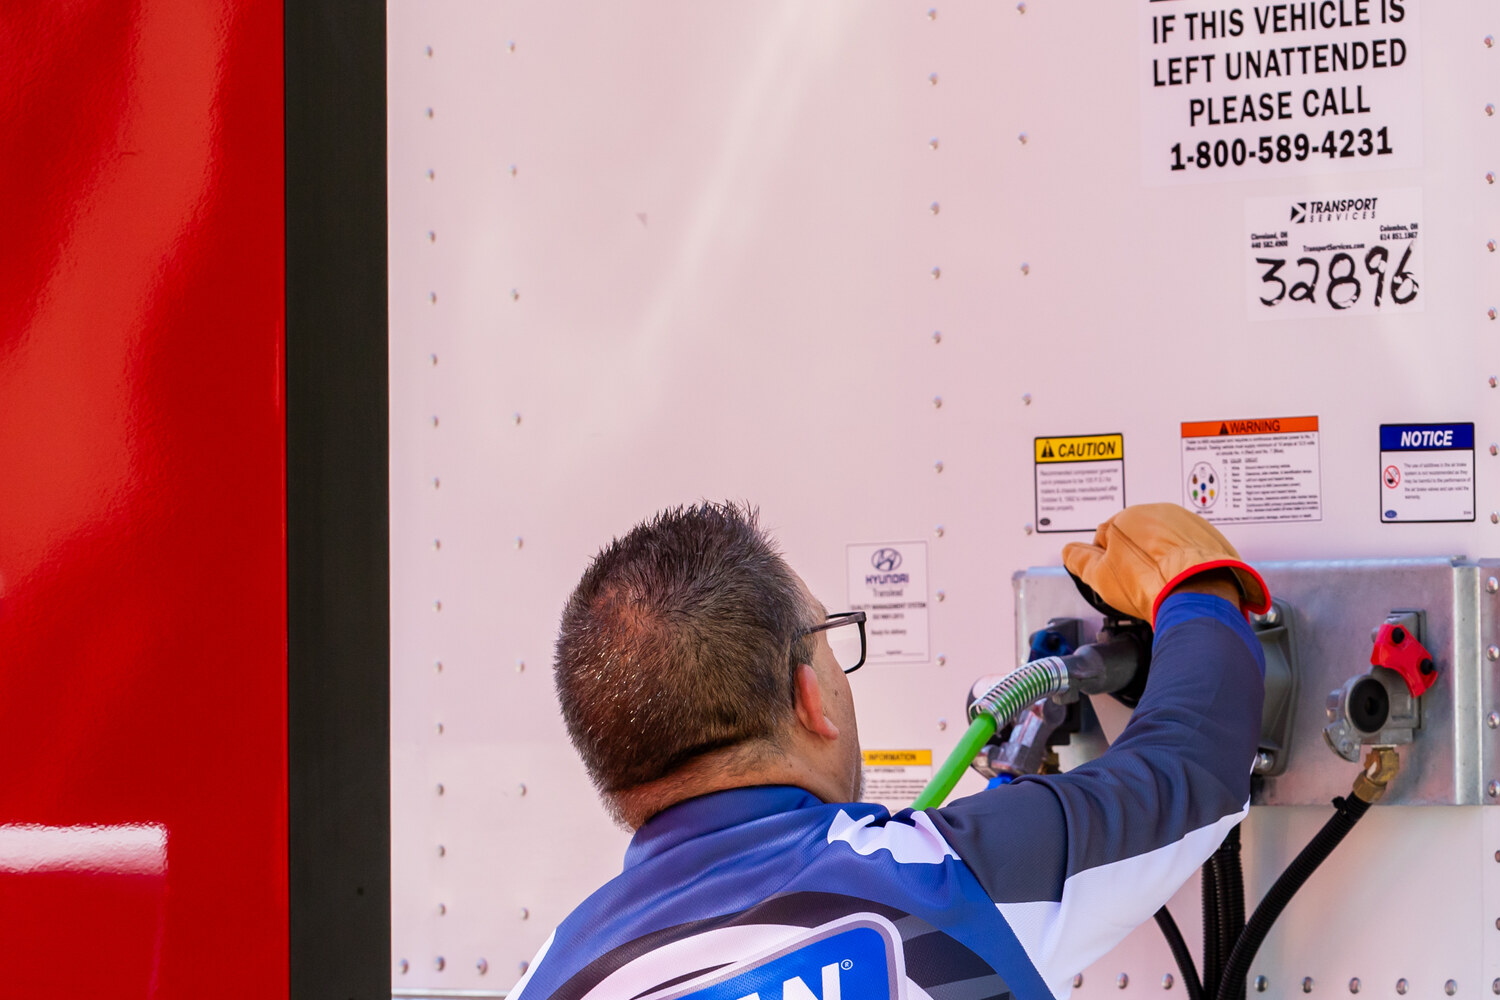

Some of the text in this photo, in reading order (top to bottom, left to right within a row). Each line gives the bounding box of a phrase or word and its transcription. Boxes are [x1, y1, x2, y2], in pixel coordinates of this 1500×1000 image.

[1152, 0, 1406, 44] IF THIS VEHICLE IS
[1153, 38, 1408, 87] LEFT UNATTENDED
[1190, 85, 1371, 127] PLEASE CALL
[1170, 126, 1394, 171] 1-800-589-4231
[1310, 197, 1378, 214] TRANSPORT
[1255, 240, 1420, 311] 32896
[1229, 419, 1281, 434] WARNING
[1400, 430, 1454, 447] NOTICE
[1058, 441, 1116, 458] CAUTION
[865, 573, 910, 585] HYUNDAI
